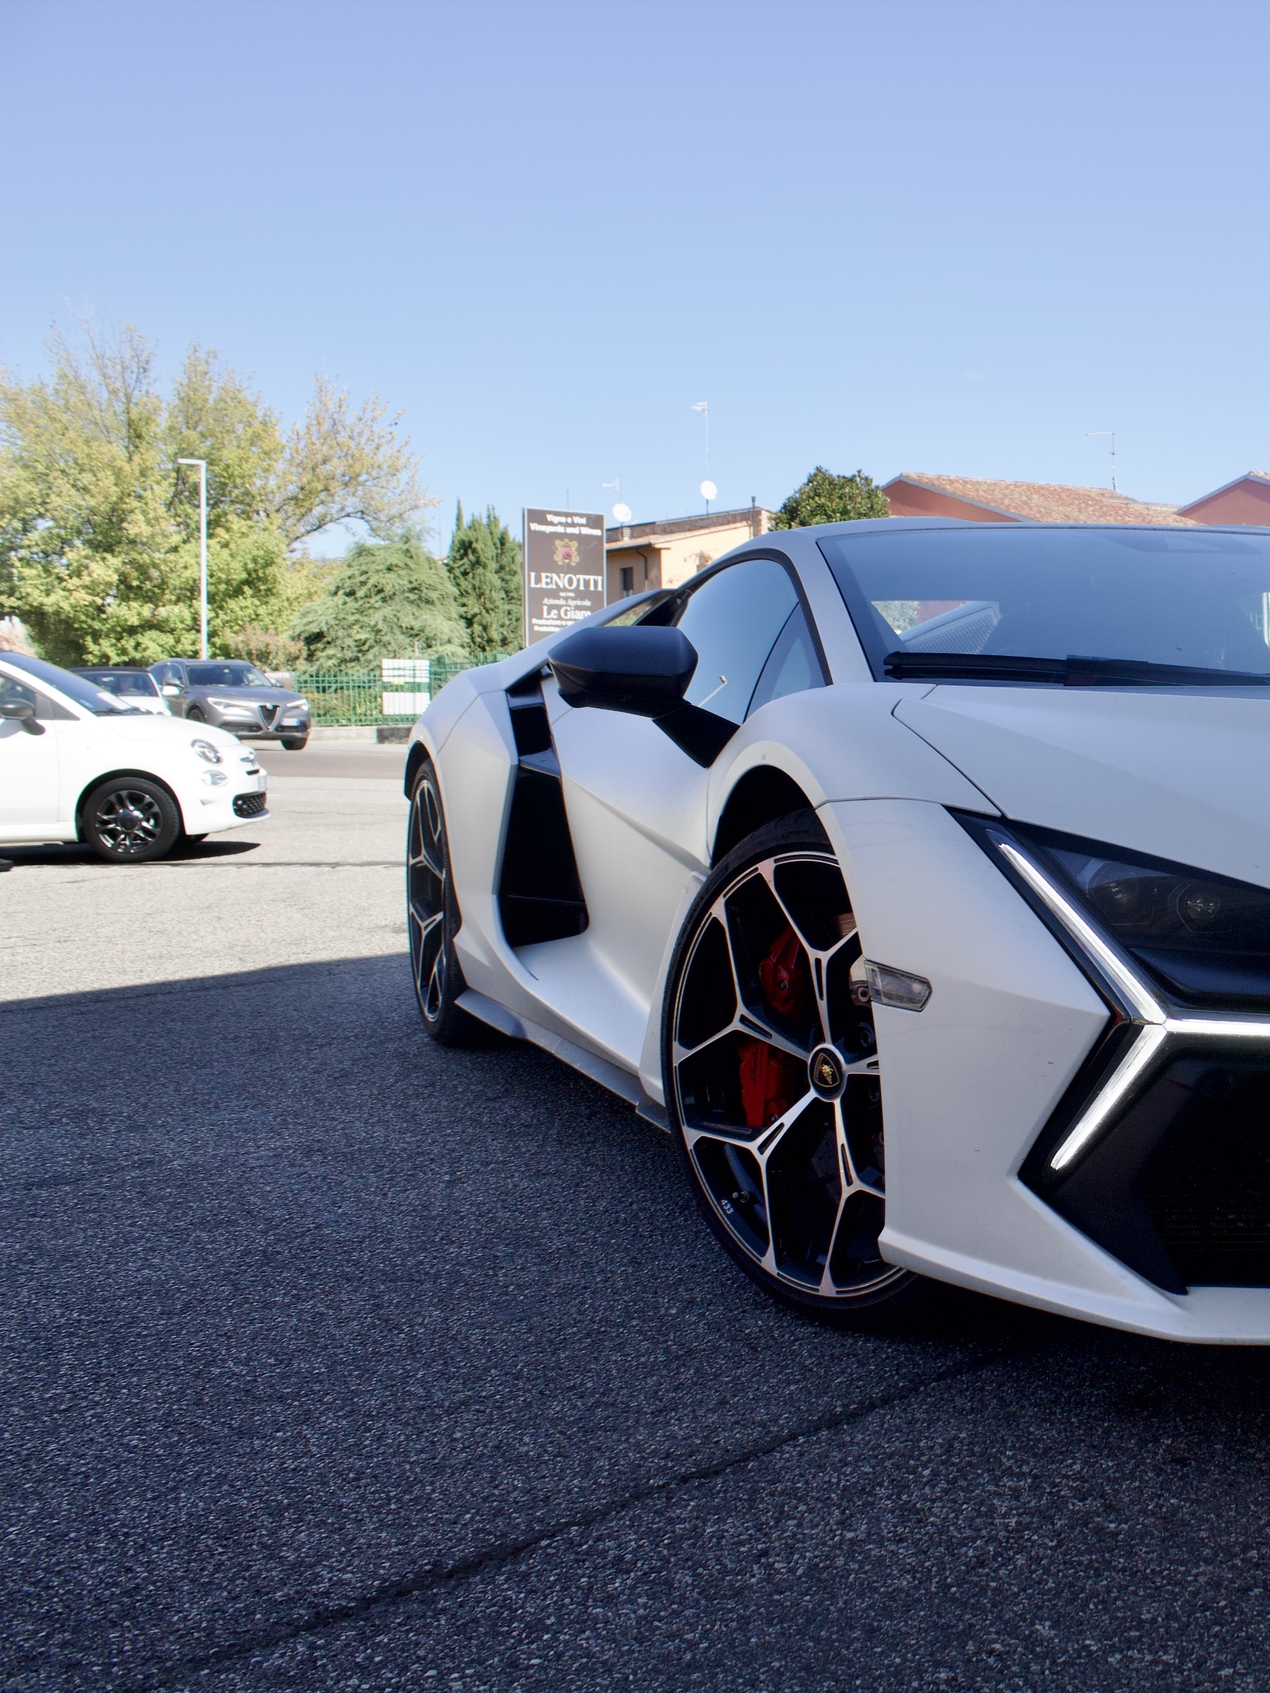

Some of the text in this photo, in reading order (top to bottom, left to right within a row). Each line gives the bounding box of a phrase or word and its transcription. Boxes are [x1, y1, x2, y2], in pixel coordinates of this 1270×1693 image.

[530, 572, 603, 591] LENOTTI
[543, 605, 558, 619] Le
[720, 1199, 734, 1215] 433
